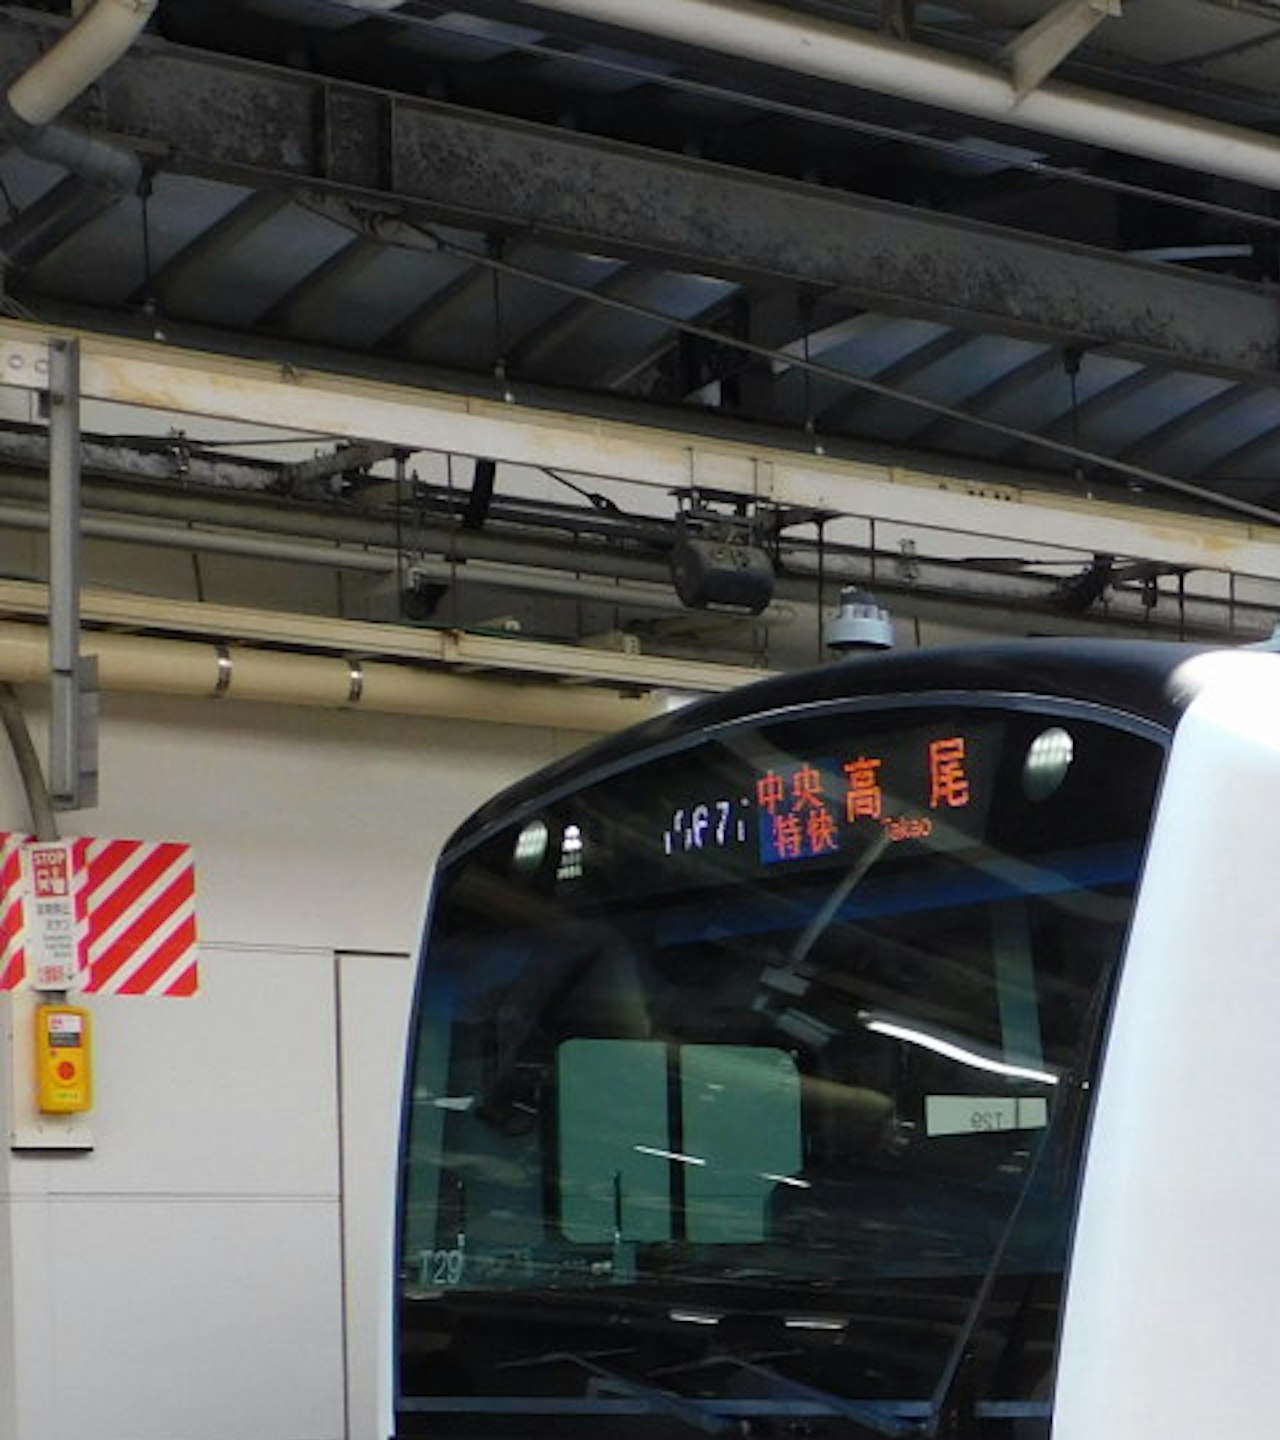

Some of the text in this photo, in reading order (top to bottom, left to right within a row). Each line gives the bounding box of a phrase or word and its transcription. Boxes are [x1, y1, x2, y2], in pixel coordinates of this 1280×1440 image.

[756, 761, 825, 814] 中央
[843, 736, 970, 823] 高尾
[772, 808, 839, 859] 特快
[420, 1249, 465, 1286] T29
